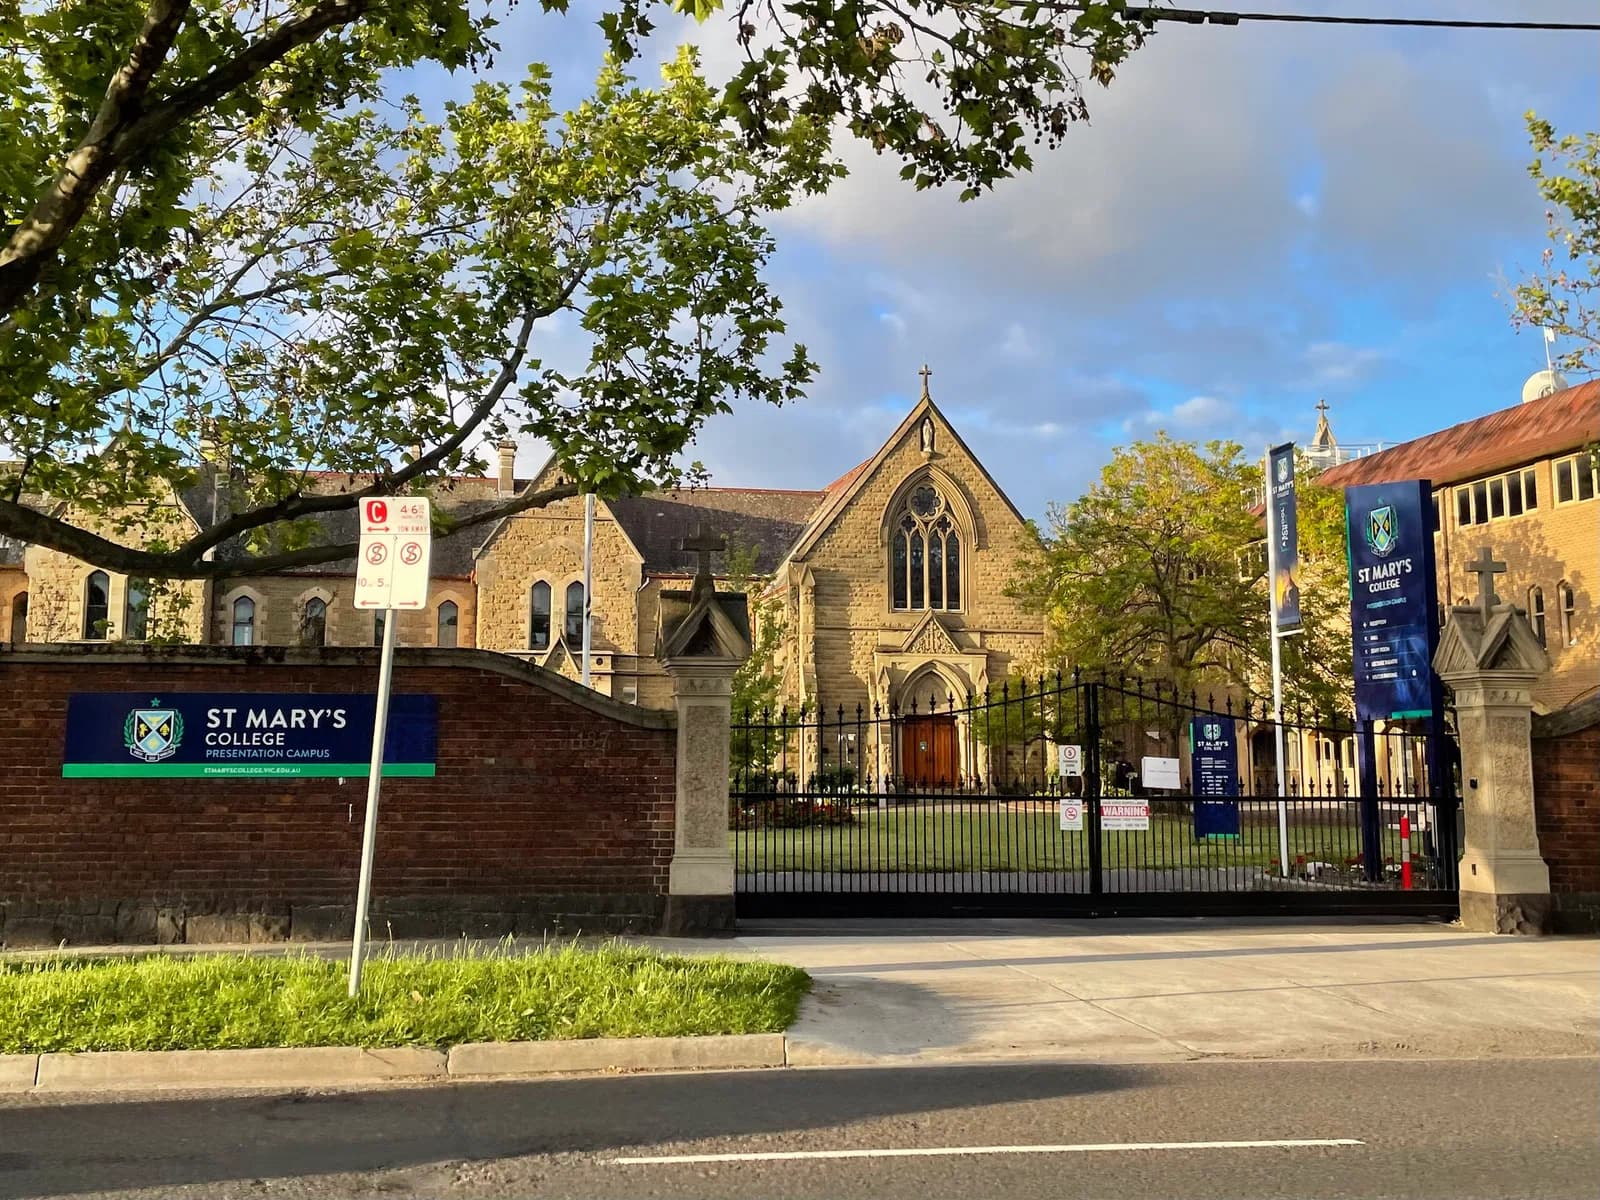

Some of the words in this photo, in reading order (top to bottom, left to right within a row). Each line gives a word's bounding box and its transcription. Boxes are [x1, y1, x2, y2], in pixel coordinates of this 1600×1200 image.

[371, 502, 382, 522] C
[1358, 567, 1370, 583] ST
[1372, 558, 1412, 581] MARY'S
[1369, 578, 1401, 593] COLLEGE
[206, 708, 238, 729] ST
[246, 708, 347, 729] MARY'S
[205, 732, 285, 746] COLLEGE
[205, 749, 284, 758] PRESENTATION
[286, 749, 330, 758] CAMPUS
[1103, 806, 1147, 817] WARNING
